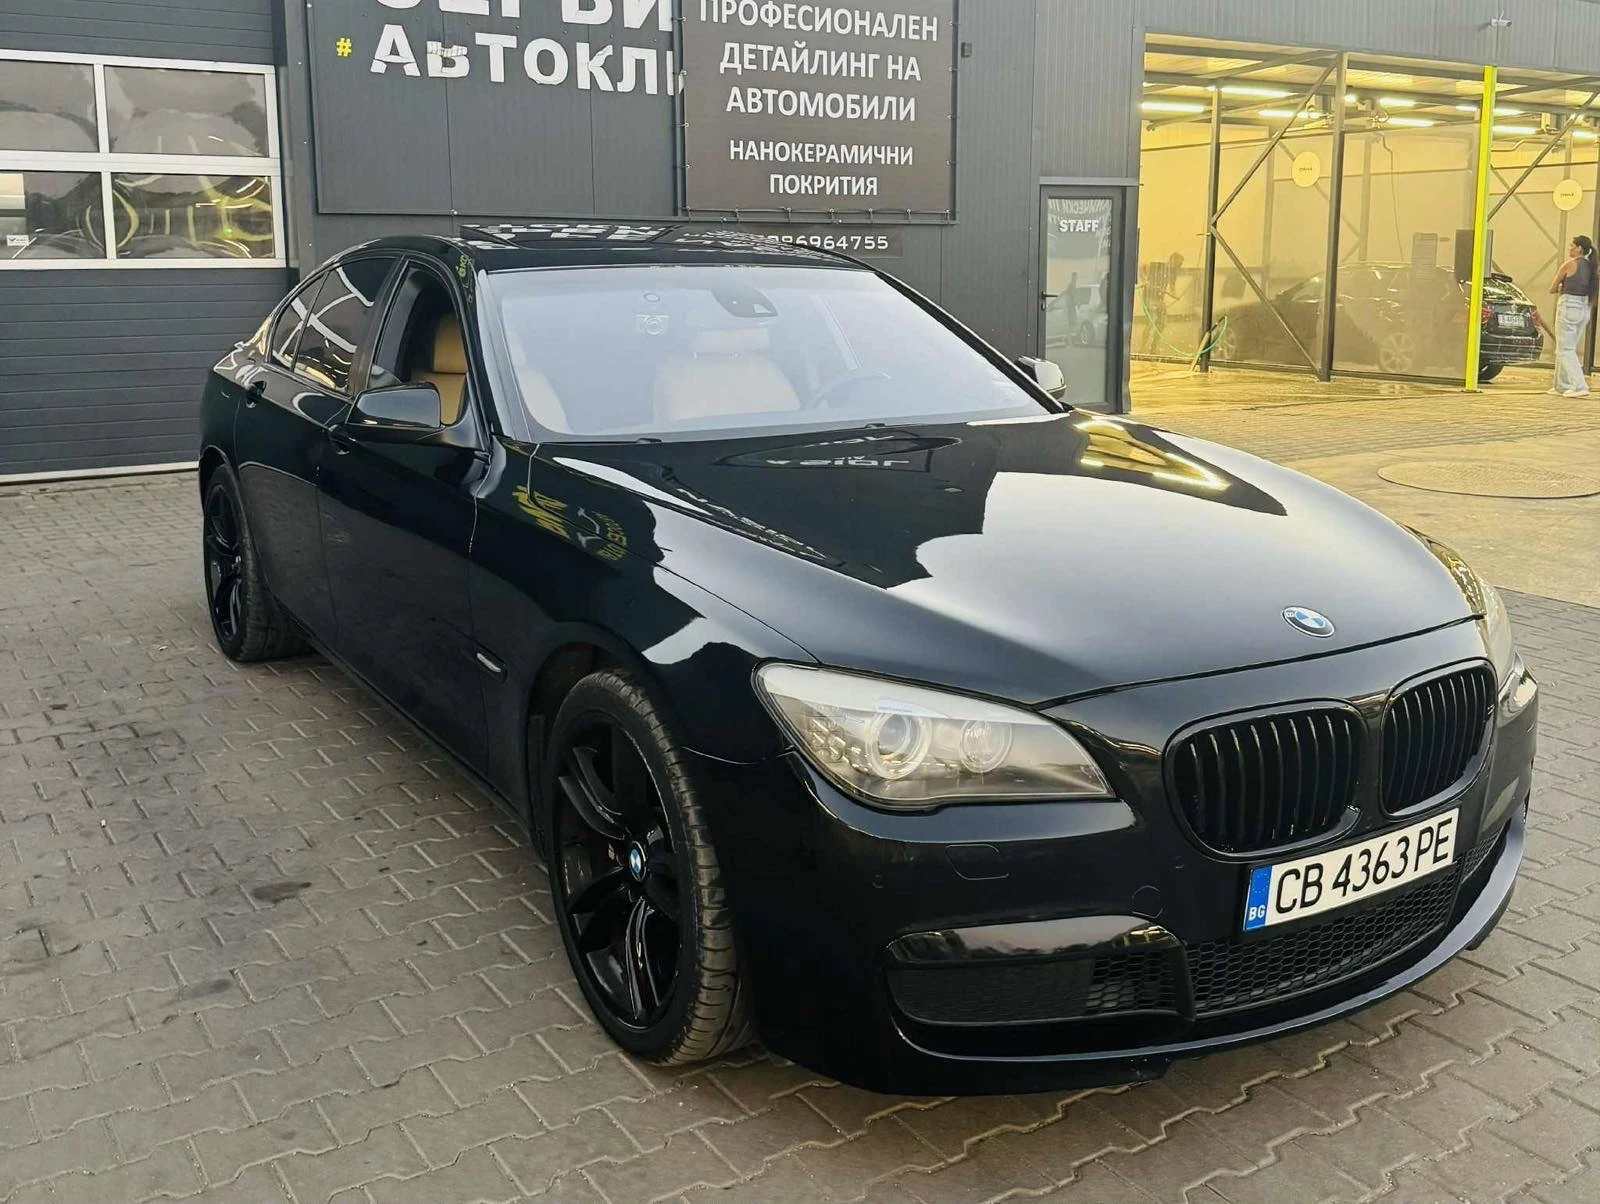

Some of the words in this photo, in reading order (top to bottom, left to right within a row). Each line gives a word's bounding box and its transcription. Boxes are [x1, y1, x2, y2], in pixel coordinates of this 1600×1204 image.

[700, 0, 938, 41] ПРОФЕСИОНАЛЕН
[719, 40, 880, 79] ДЕТАЙЛИНГ
[887, 54, 922, 81] НА
[725, 86, 916, 122] АВТОМОБИЛИ
[729, 139, 914, 166] НАНОКЕРАМИЧНИ
[769, 173, 878, 196] ПОКРИТИЯ
[1059, 219, 1099, 232] STAFF
[1275, 862, 1324, 914] CB
[1332, 835, 1410, 897] 4363
[1414, 817, 1453, 873] PE
[1248, 904, 1266, 921] BG
